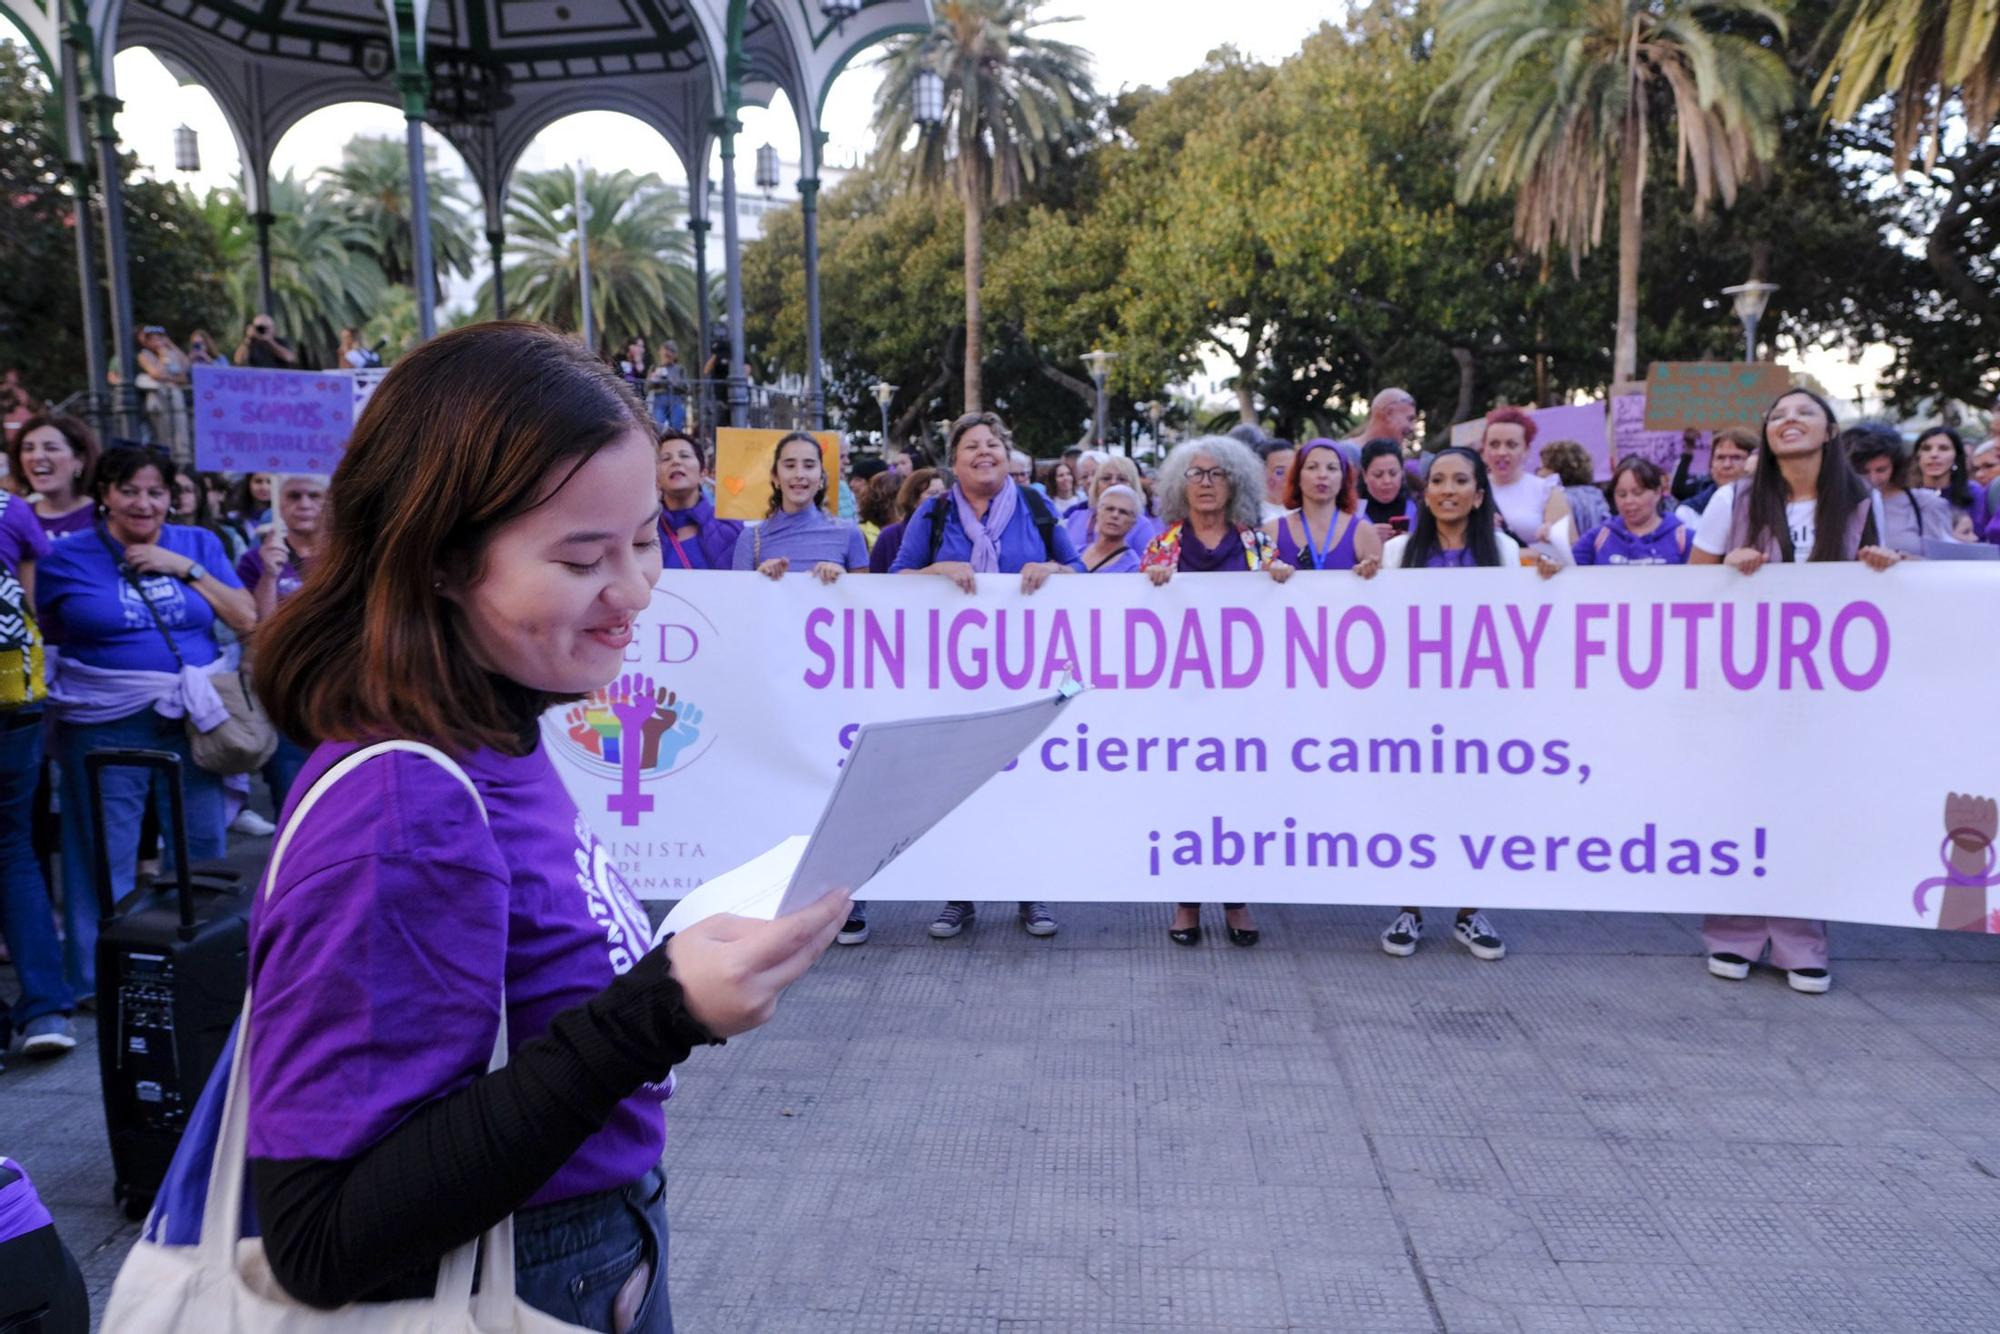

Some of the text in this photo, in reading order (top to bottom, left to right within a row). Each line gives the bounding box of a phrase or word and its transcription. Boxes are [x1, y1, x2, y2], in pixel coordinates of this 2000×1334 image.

[240, 400, 325, 430] SOMOS
[803, 600, 1891, 693] SIN IGUALDAD NO HAY FUTURO
[1041, 722, 1267, 773] cierran
[1292, 723, 1591, 784] caminos,
[1149, 815, 1767, 878] ¡abrimos veredas!
[625, 877, 704, 889] ANARIA
